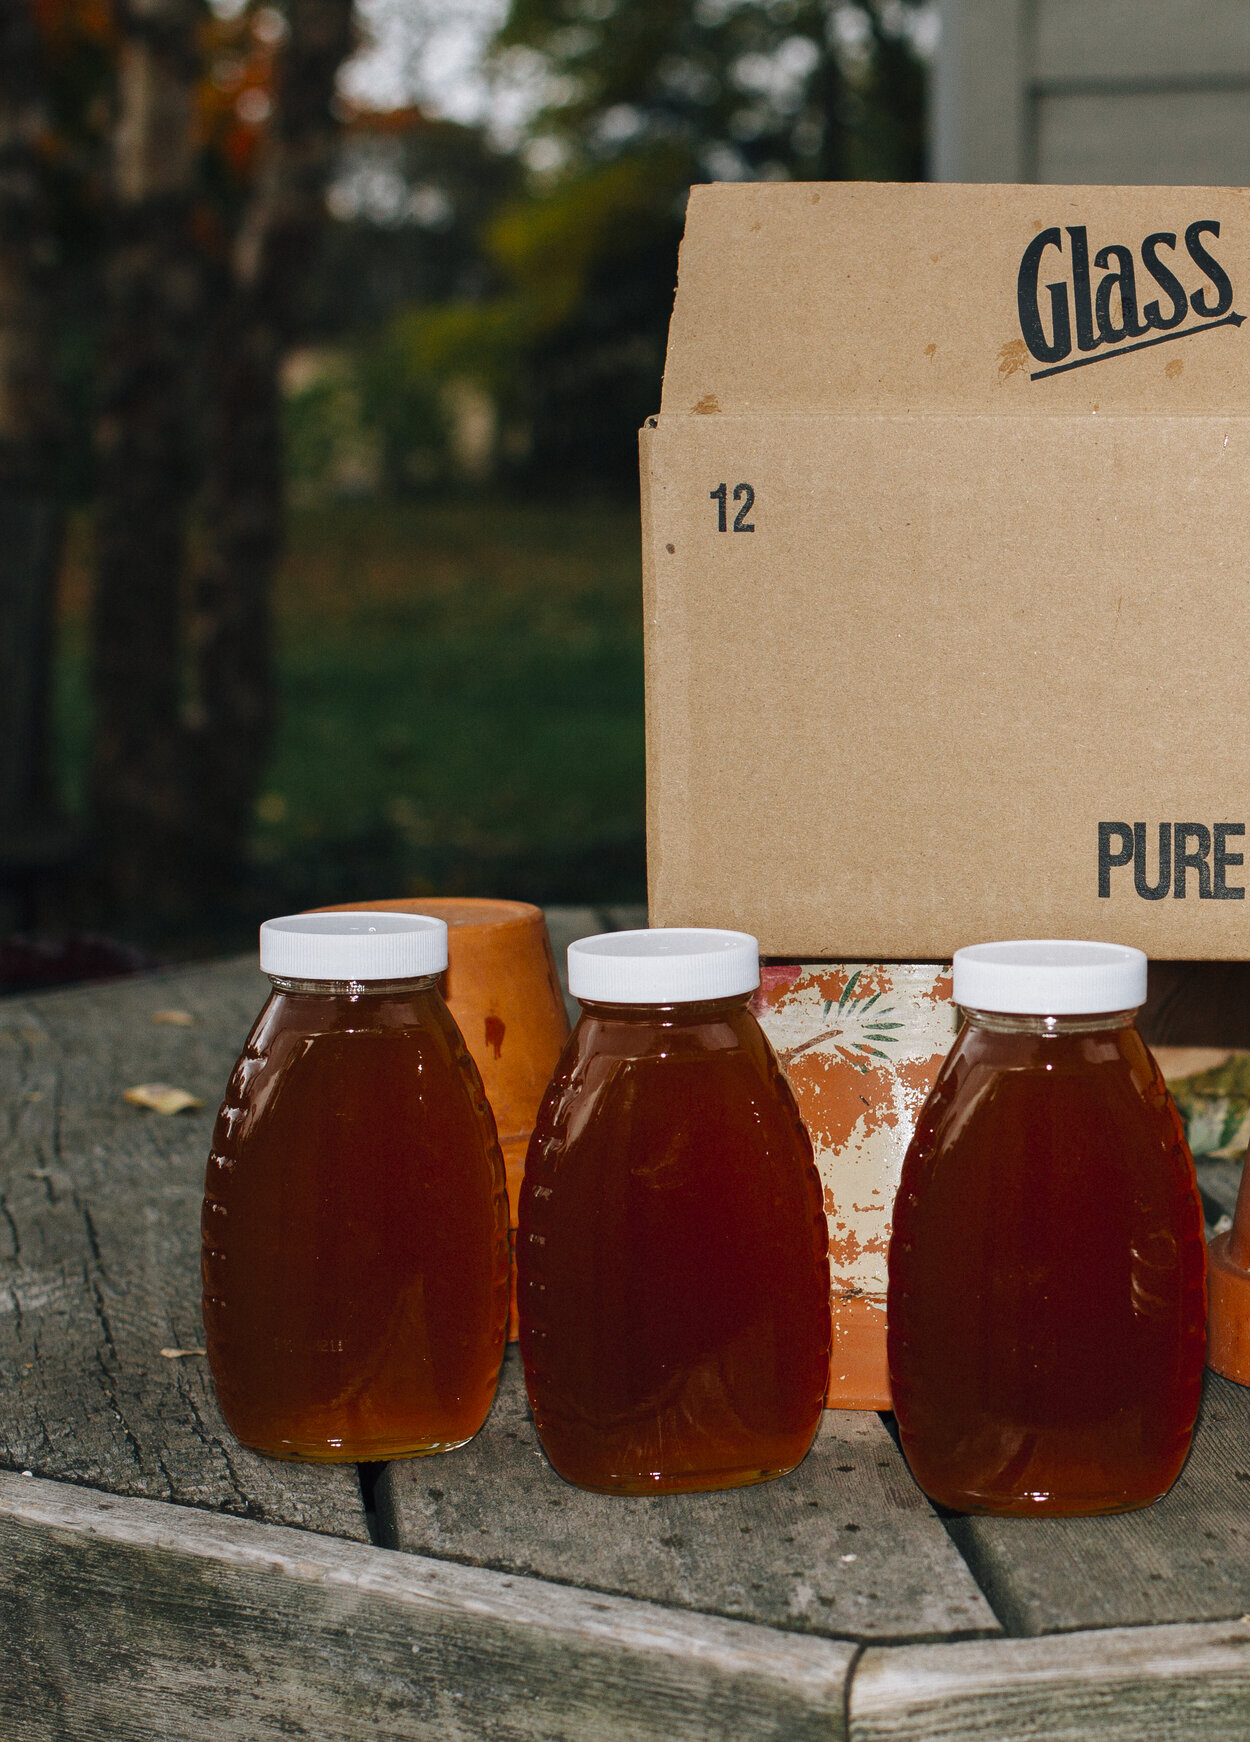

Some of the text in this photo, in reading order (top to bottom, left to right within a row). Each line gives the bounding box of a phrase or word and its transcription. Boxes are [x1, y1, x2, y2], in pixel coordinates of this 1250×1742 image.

[1016, 219, 1235, 364] Glass
[706, 482, 756, 533] 12
[1097, 821, 1247, 901] PURE
